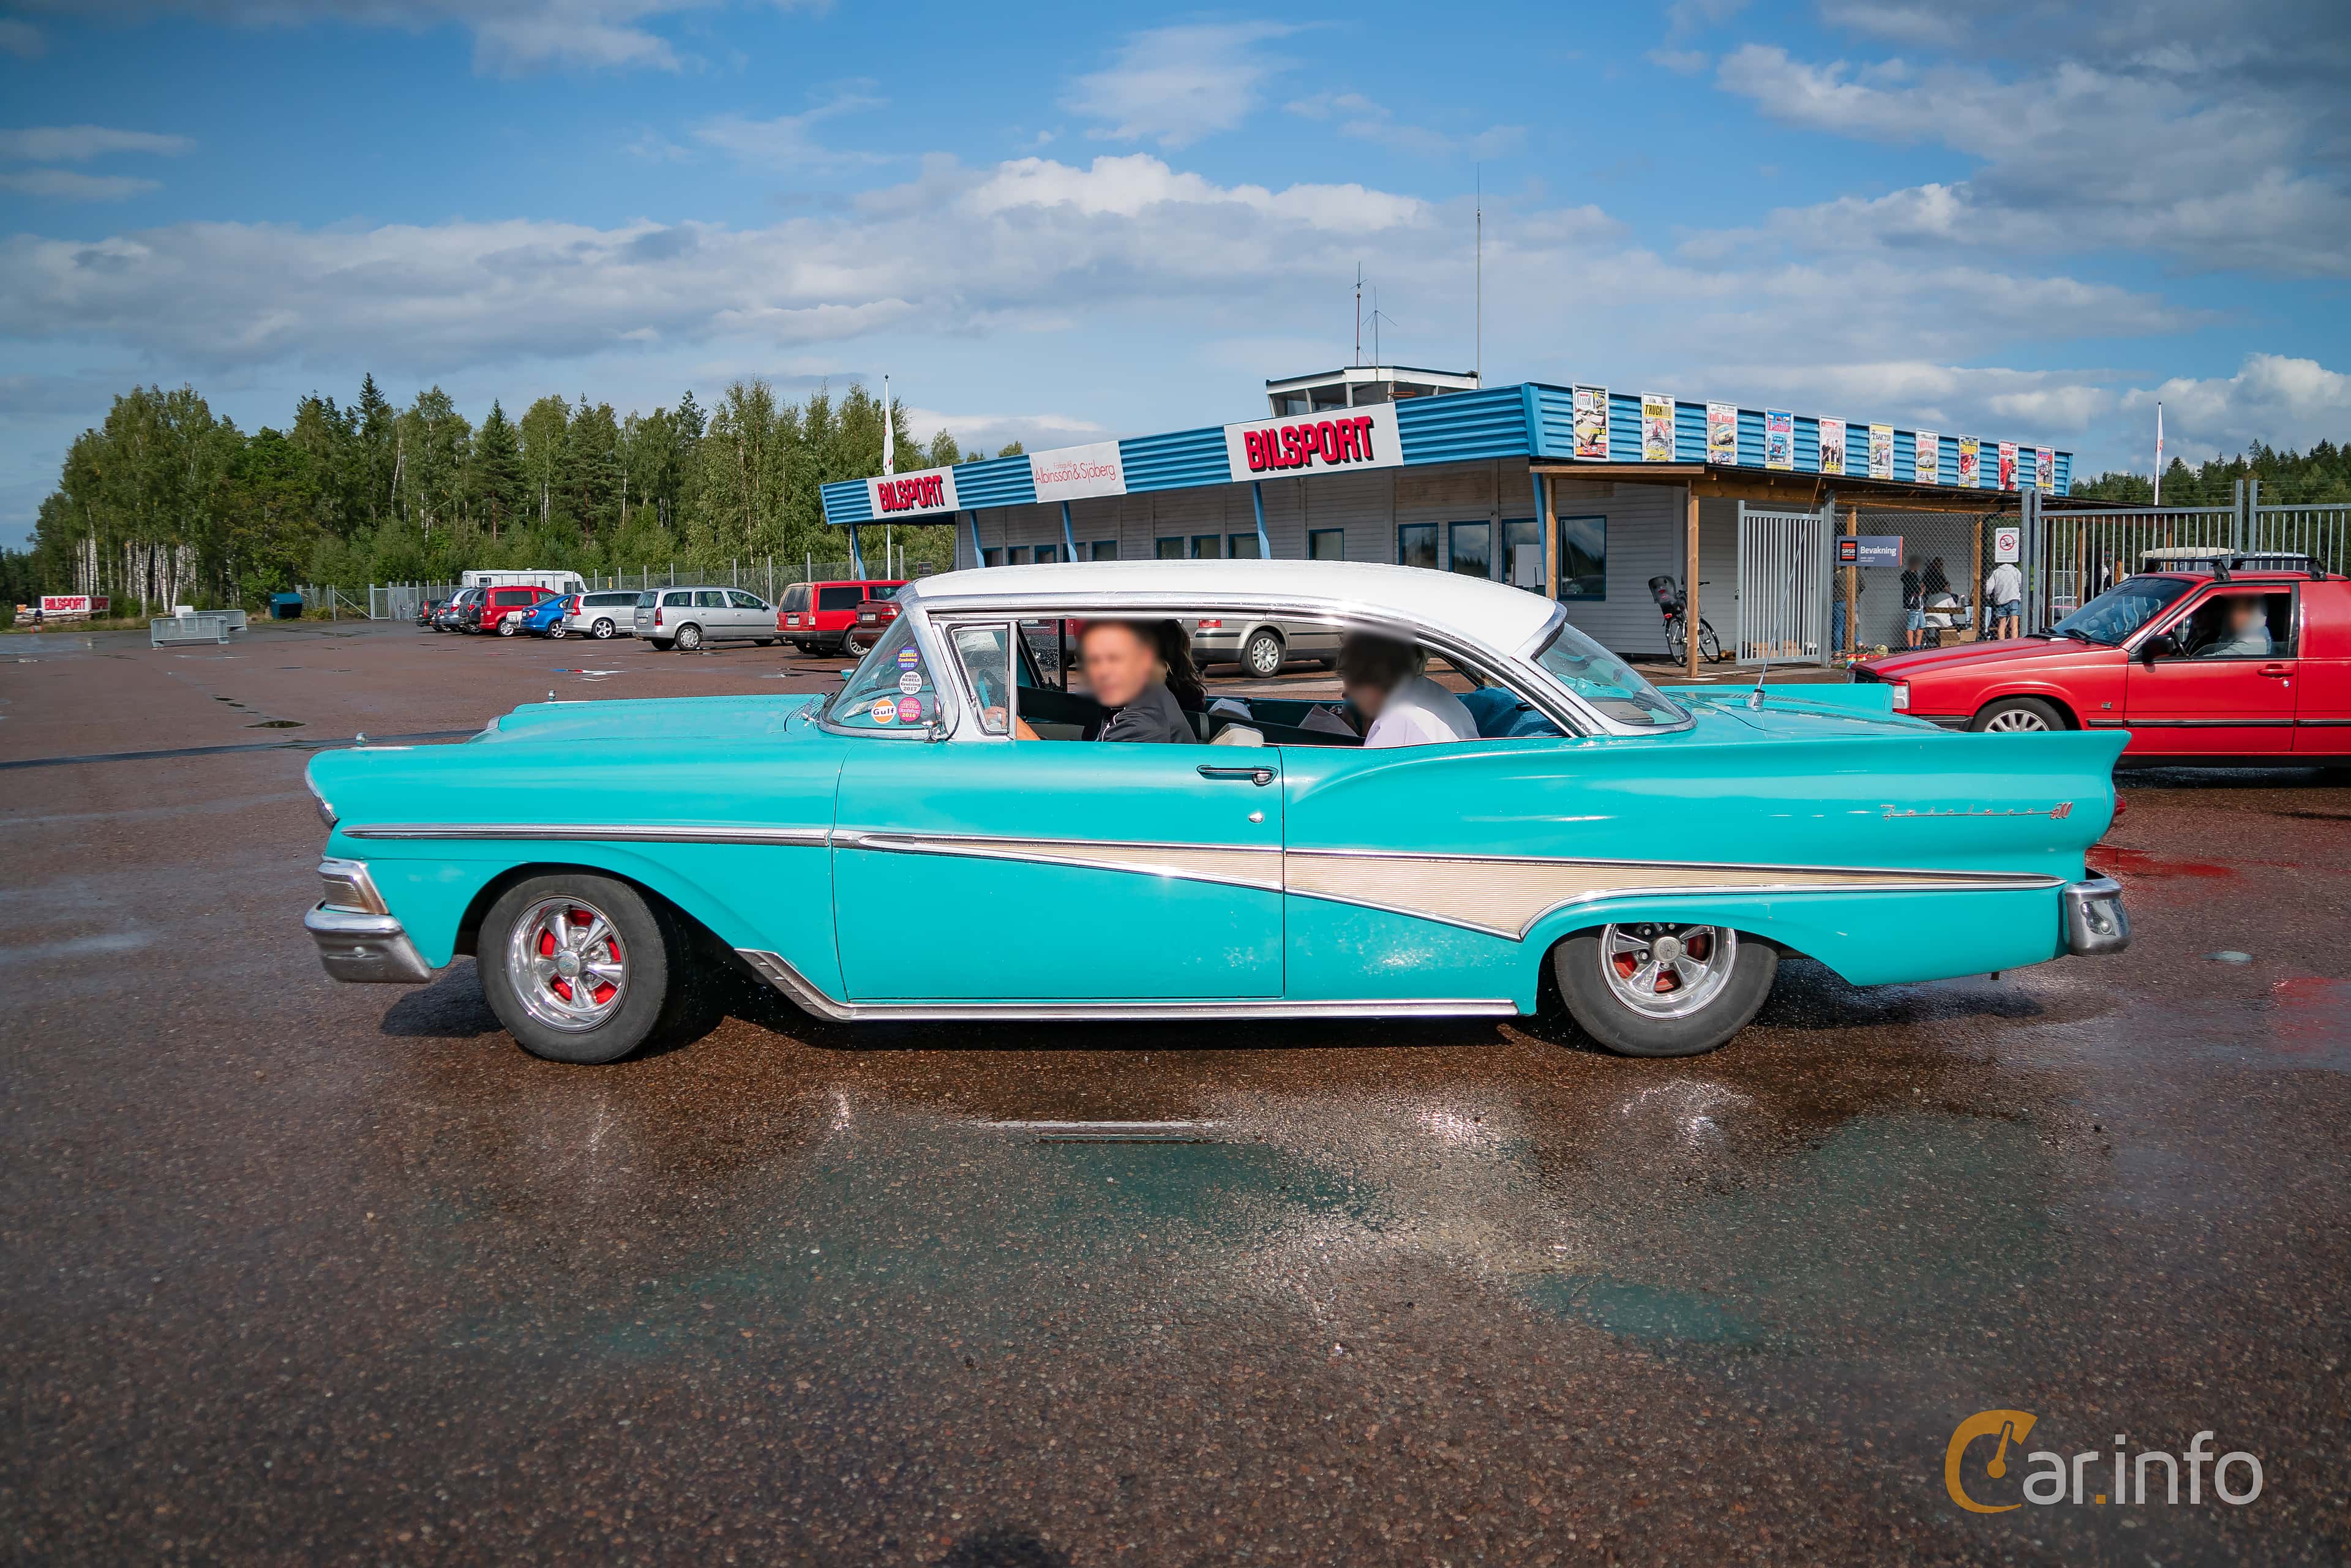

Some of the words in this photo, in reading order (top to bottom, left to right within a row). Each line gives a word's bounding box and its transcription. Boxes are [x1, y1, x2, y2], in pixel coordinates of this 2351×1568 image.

[1244, 416, 1375, 473] BILSPORT
[877, 475, 945, 512] BILSPORT
[1861, 546, 1897, 557] Bevakning
[44, 597, 86, 610] BILSPORT
